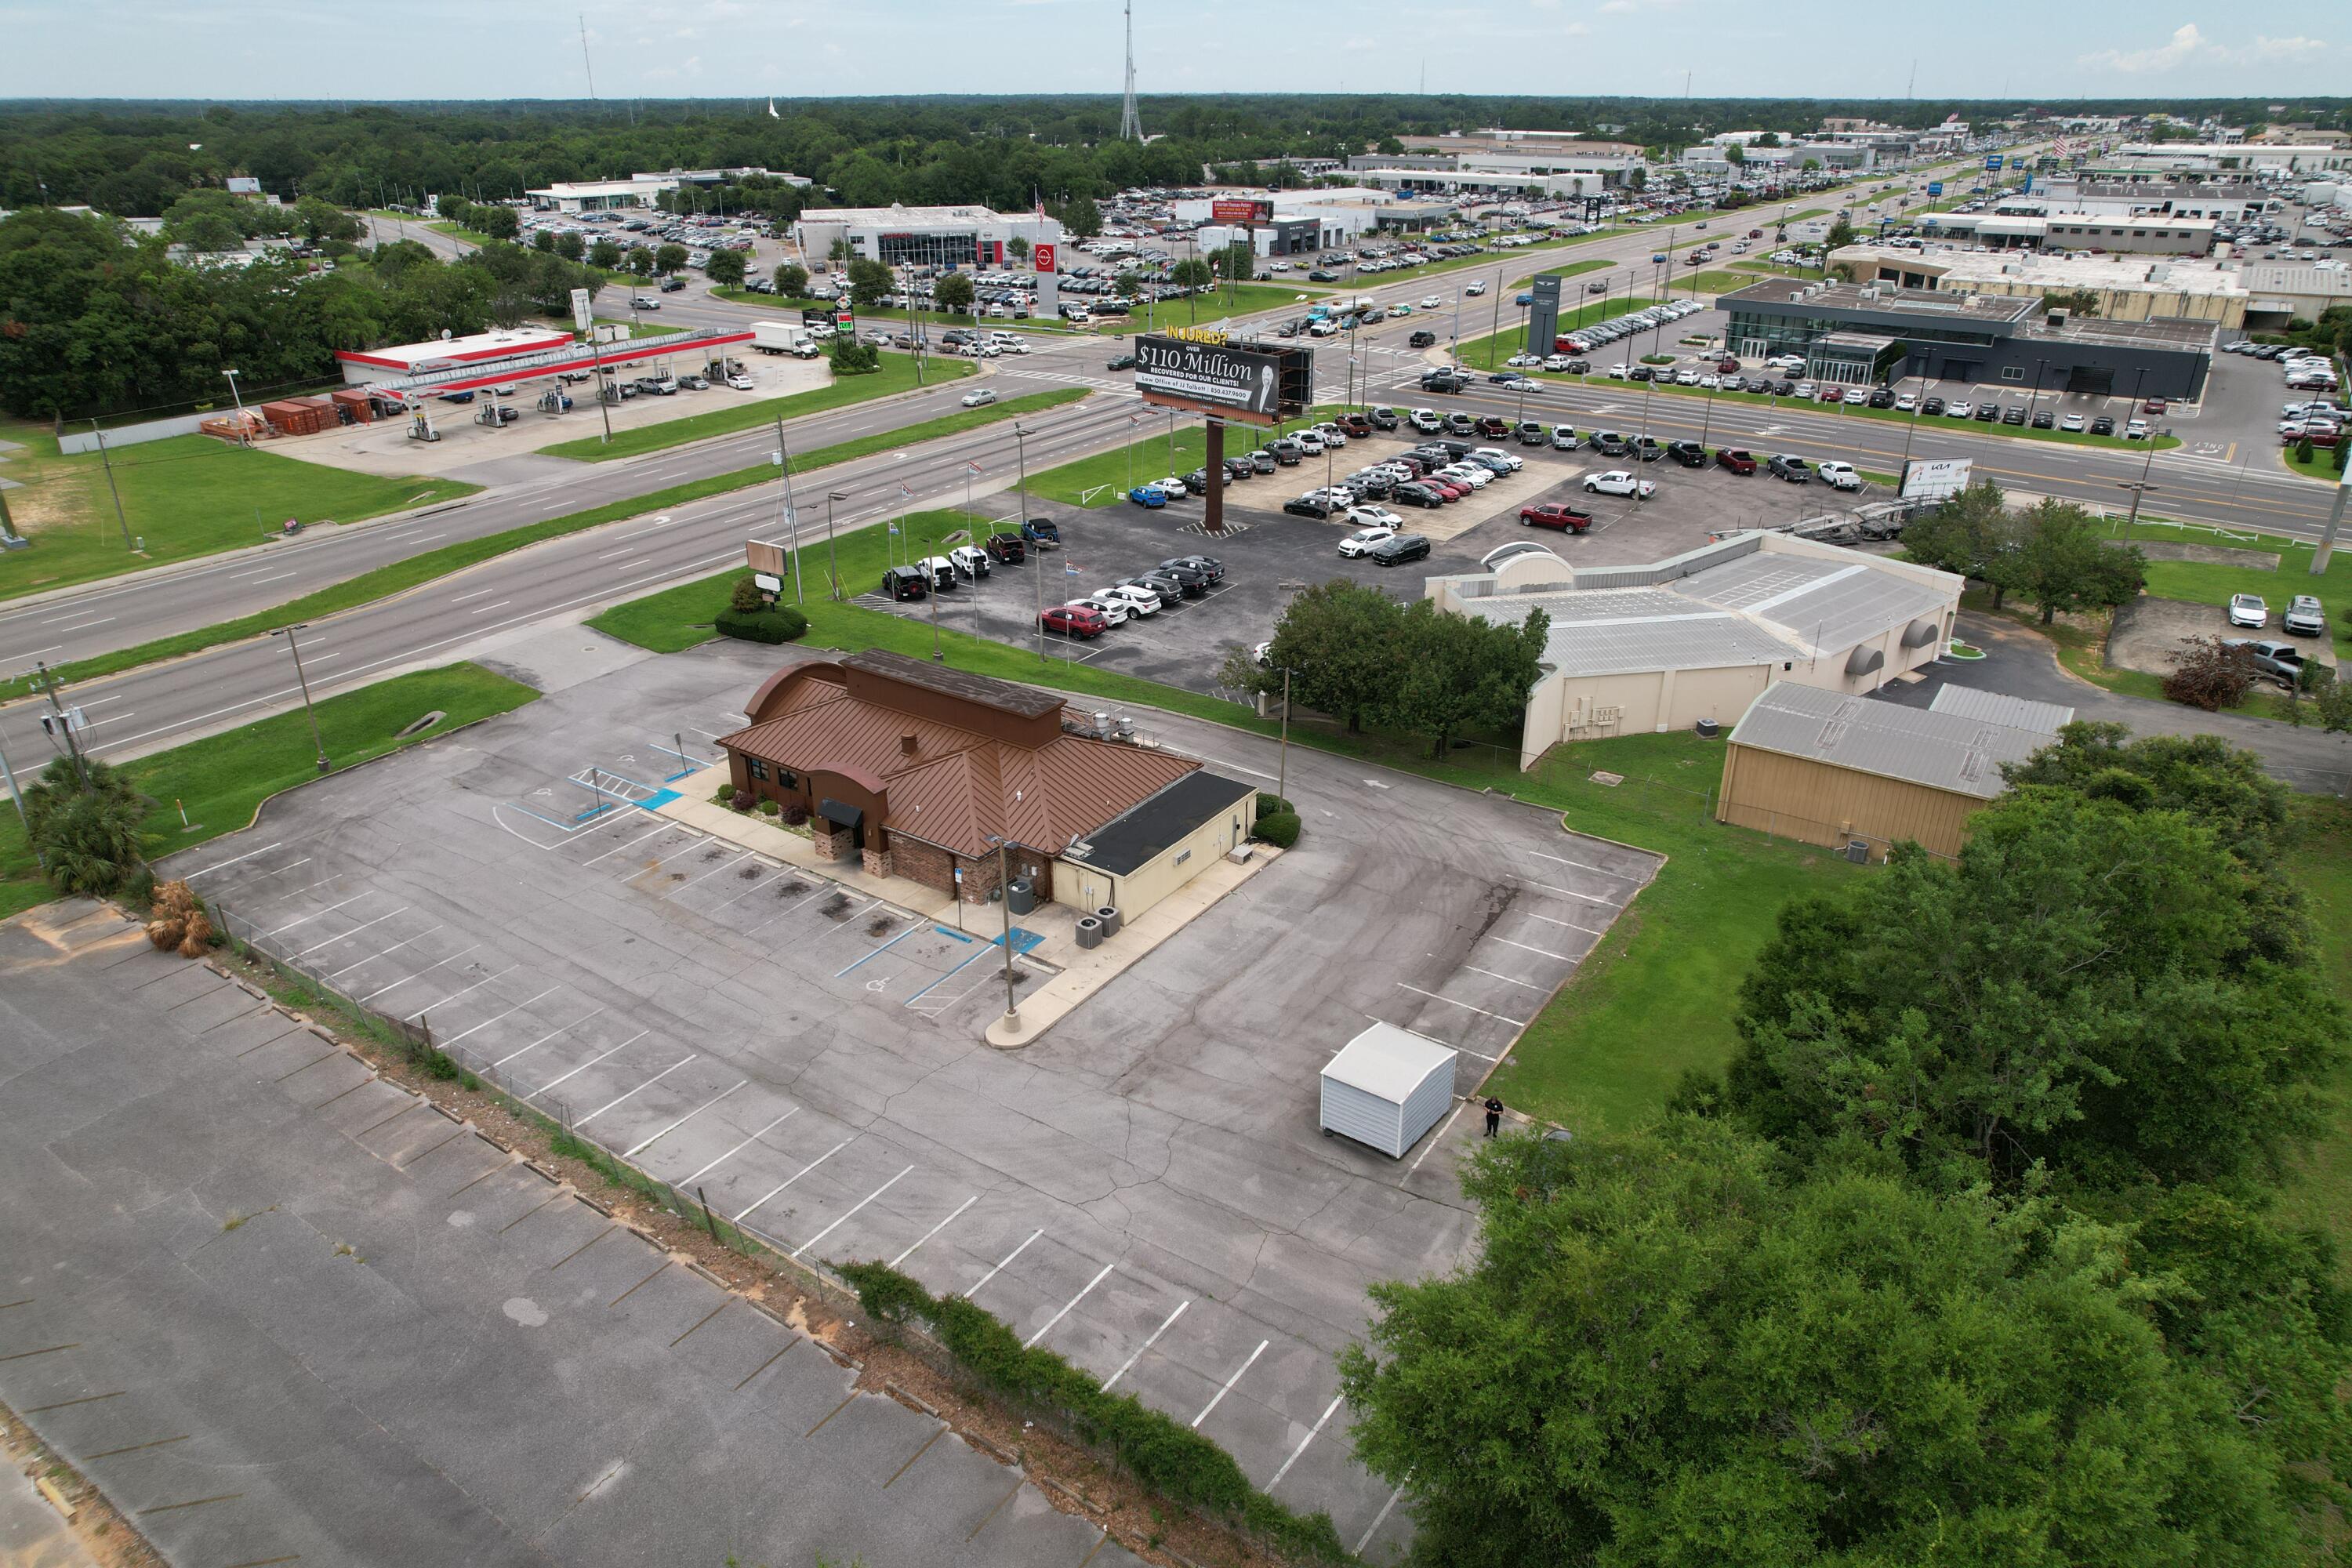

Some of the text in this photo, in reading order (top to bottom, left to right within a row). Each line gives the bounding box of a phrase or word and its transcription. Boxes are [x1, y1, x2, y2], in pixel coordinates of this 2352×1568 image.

[1167, 325, 1228, 346] INJURED?
[1138, 344, 1253, 381] $110 Million
[1150, 367, 1185, 378] RECOVERED
[1213, 377, 1240, 387] CLIENTS!
[1210, 387, 1247, 398] 850.437.9600
[2194, 441, 2224, 450] ONLY
